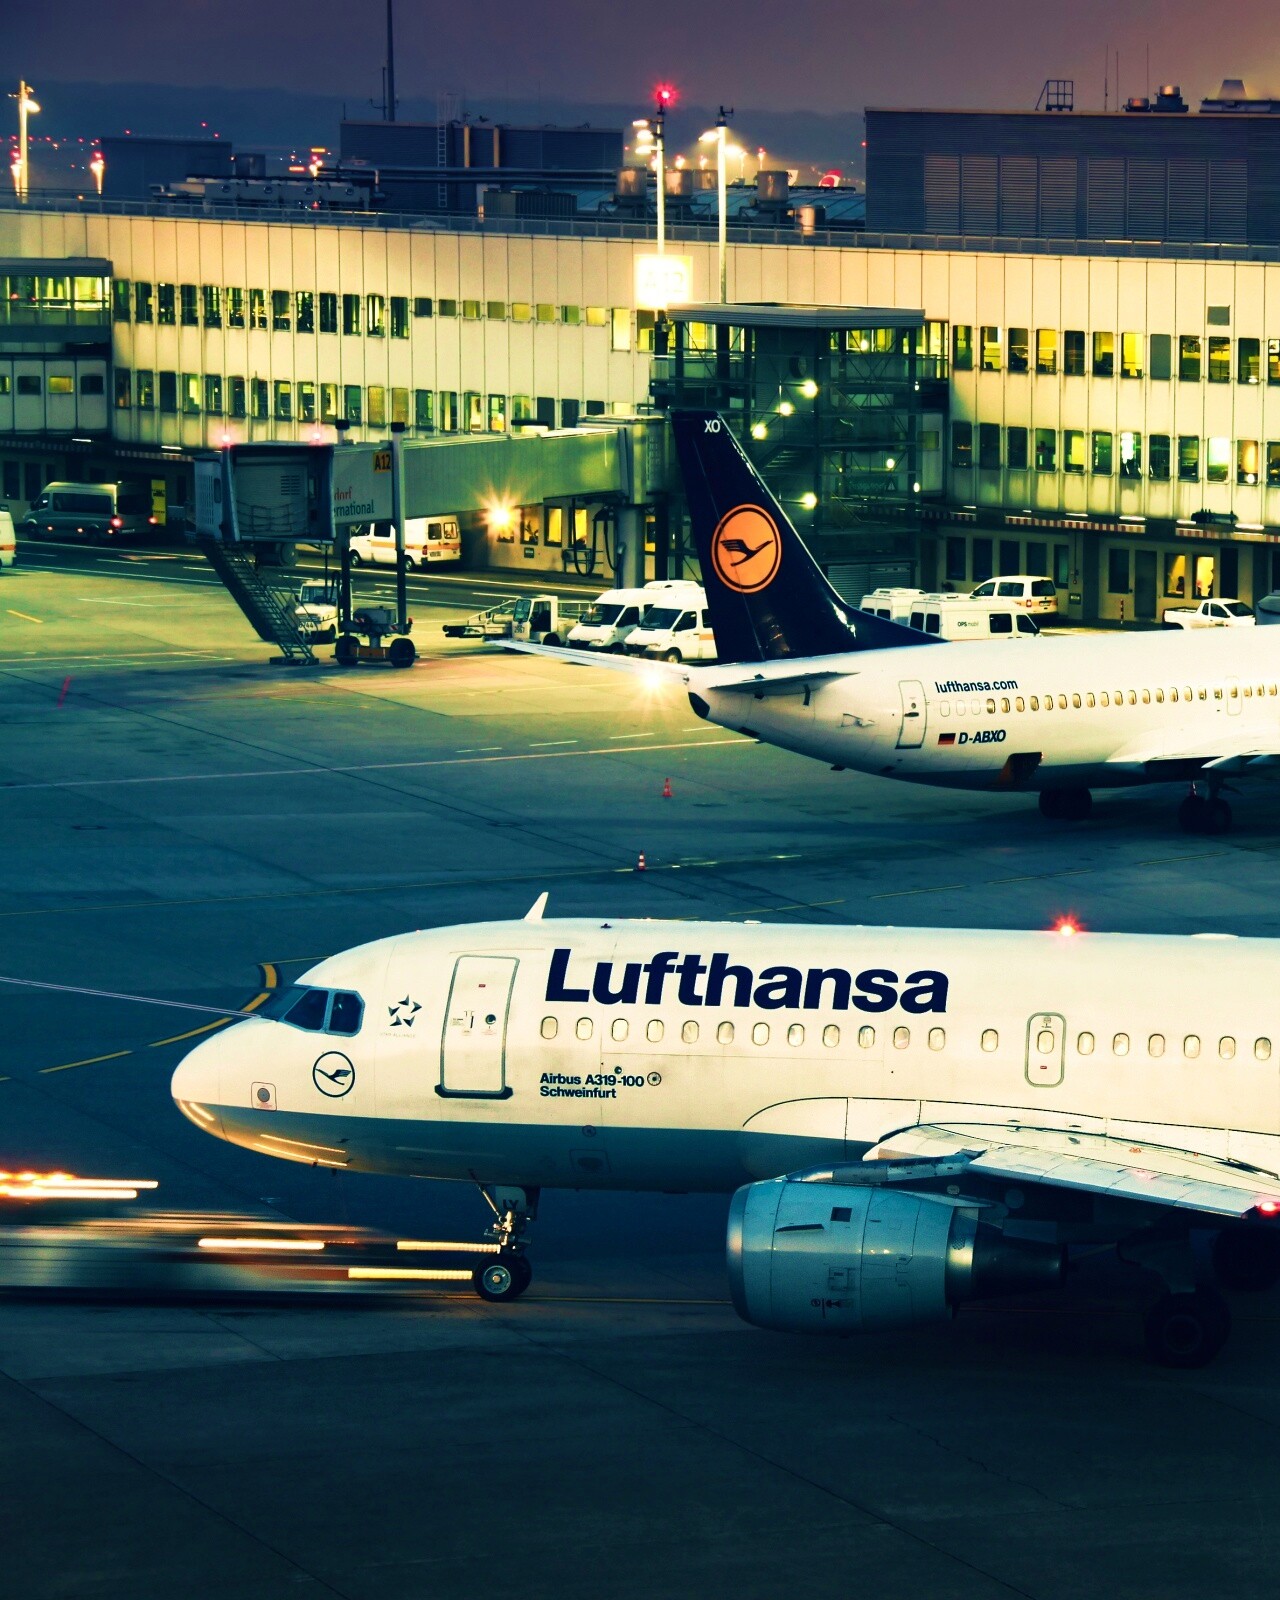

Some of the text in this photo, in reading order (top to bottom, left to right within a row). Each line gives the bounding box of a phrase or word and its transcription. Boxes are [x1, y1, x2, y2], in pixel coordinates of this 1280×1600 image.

[704, 419, 721, 433] XO
[374, 454, 391, 470] A12
[334, 499, 374, 517] rnational
[935, 680, 1018, 693] lufthansa.com
[958, 729, 1007, 745] D-ABXO
[545, 948, 950, 1014] Lufthansa
[540, 1073, 644, 1087] Airbus A319-100
[540, 1086, 616, 1098] Schweinfurt
